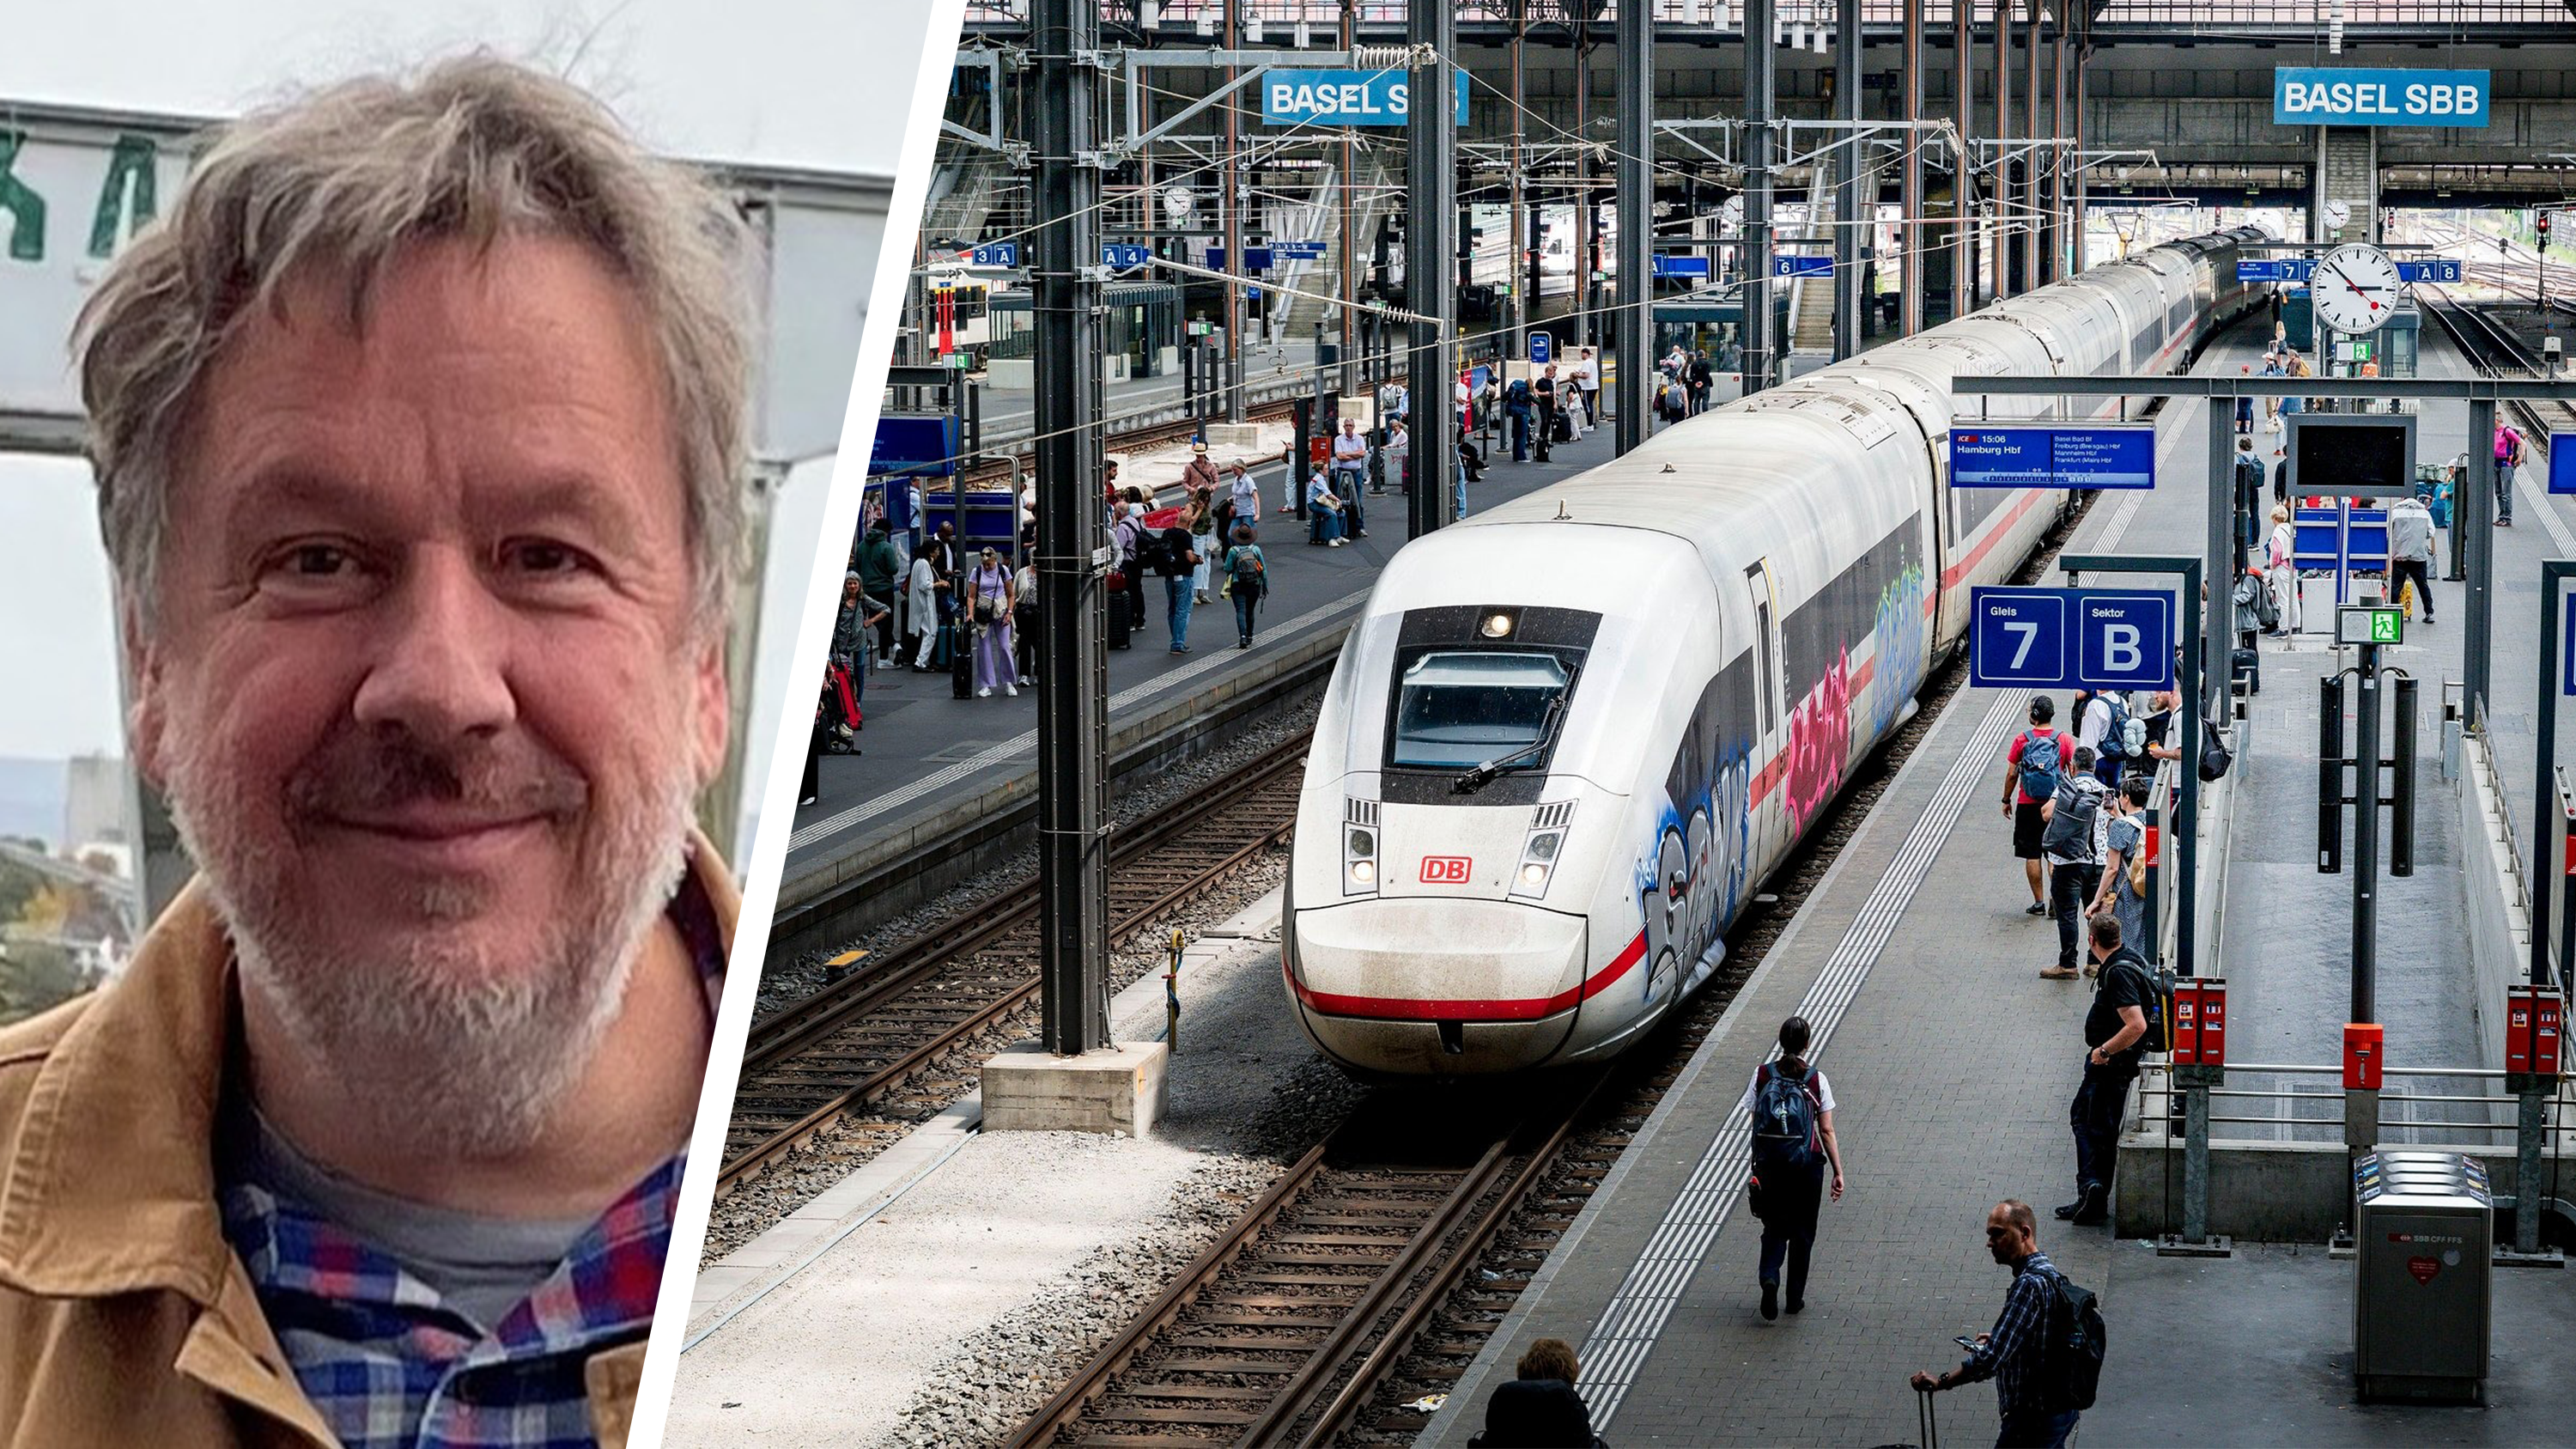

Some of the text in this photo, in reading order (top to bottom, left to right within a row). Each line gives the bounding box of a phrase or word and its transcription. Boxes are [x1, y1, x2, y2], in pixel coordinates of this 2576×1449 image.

[1272, 83, 1381, 114] BASEL
[2284, 82, 2479, 115] BASEL SBB
[978, 251, 1010, 262] 3 A
[1106, 251, 1138, 263] A 4
[1780, 262, 1790, 273] 6
[2285, 266, 2294, 278] 7
[2421, 267, 2454, 279] A 8
[1957, 446, 2021, 455] Hamburg Hbf
[1990, 606, 2017, 617] Gleis
[2092, 607, 2125, 618] Sektor
[2003, 622, 2038, 669] 7
[2104, 624, 2142, 672] B
[1425, 860, 1465, 880] DB
[2413, 1234, 2463, 1245] SBB CFF FFS
